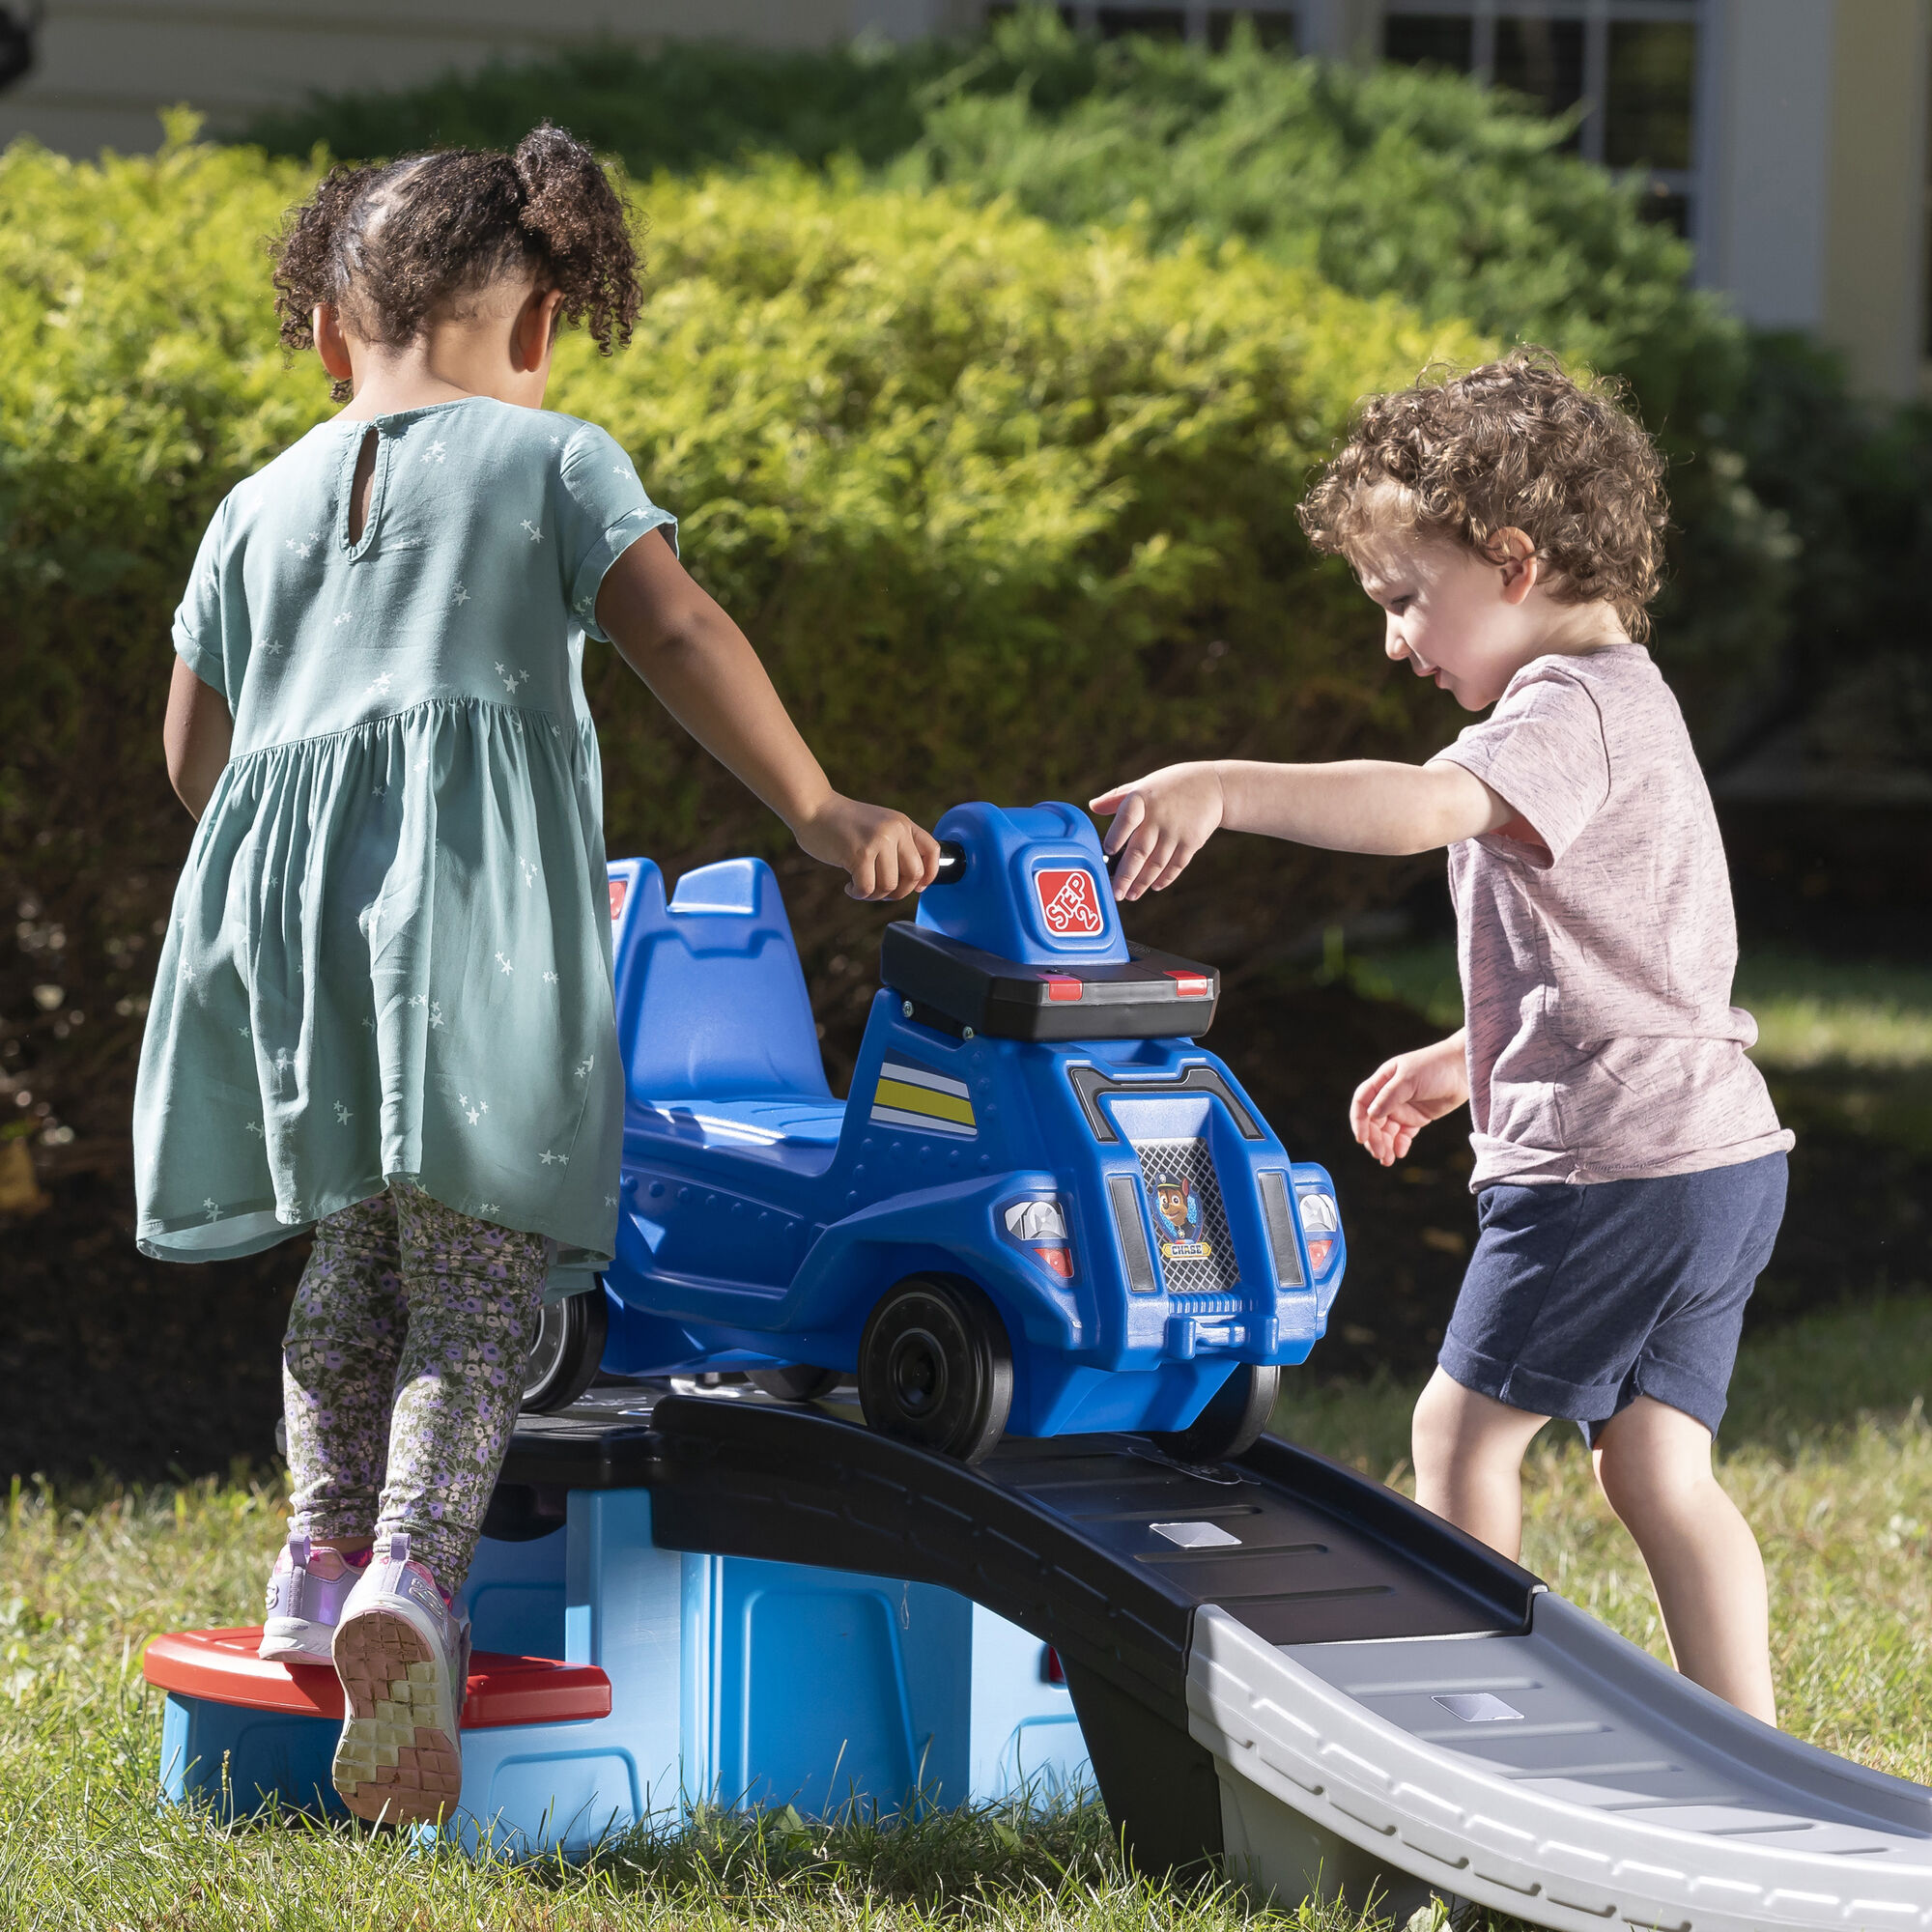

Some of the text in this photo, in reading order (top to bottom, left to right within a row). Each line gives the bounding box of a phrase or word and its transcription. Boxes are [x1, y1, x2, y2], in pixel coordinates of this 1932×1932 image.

[1046, 872, 1086, 929] STEP
[1075, 903, 1098, 930] 2
[1171, 1244, 1203, 1255] CHASE
